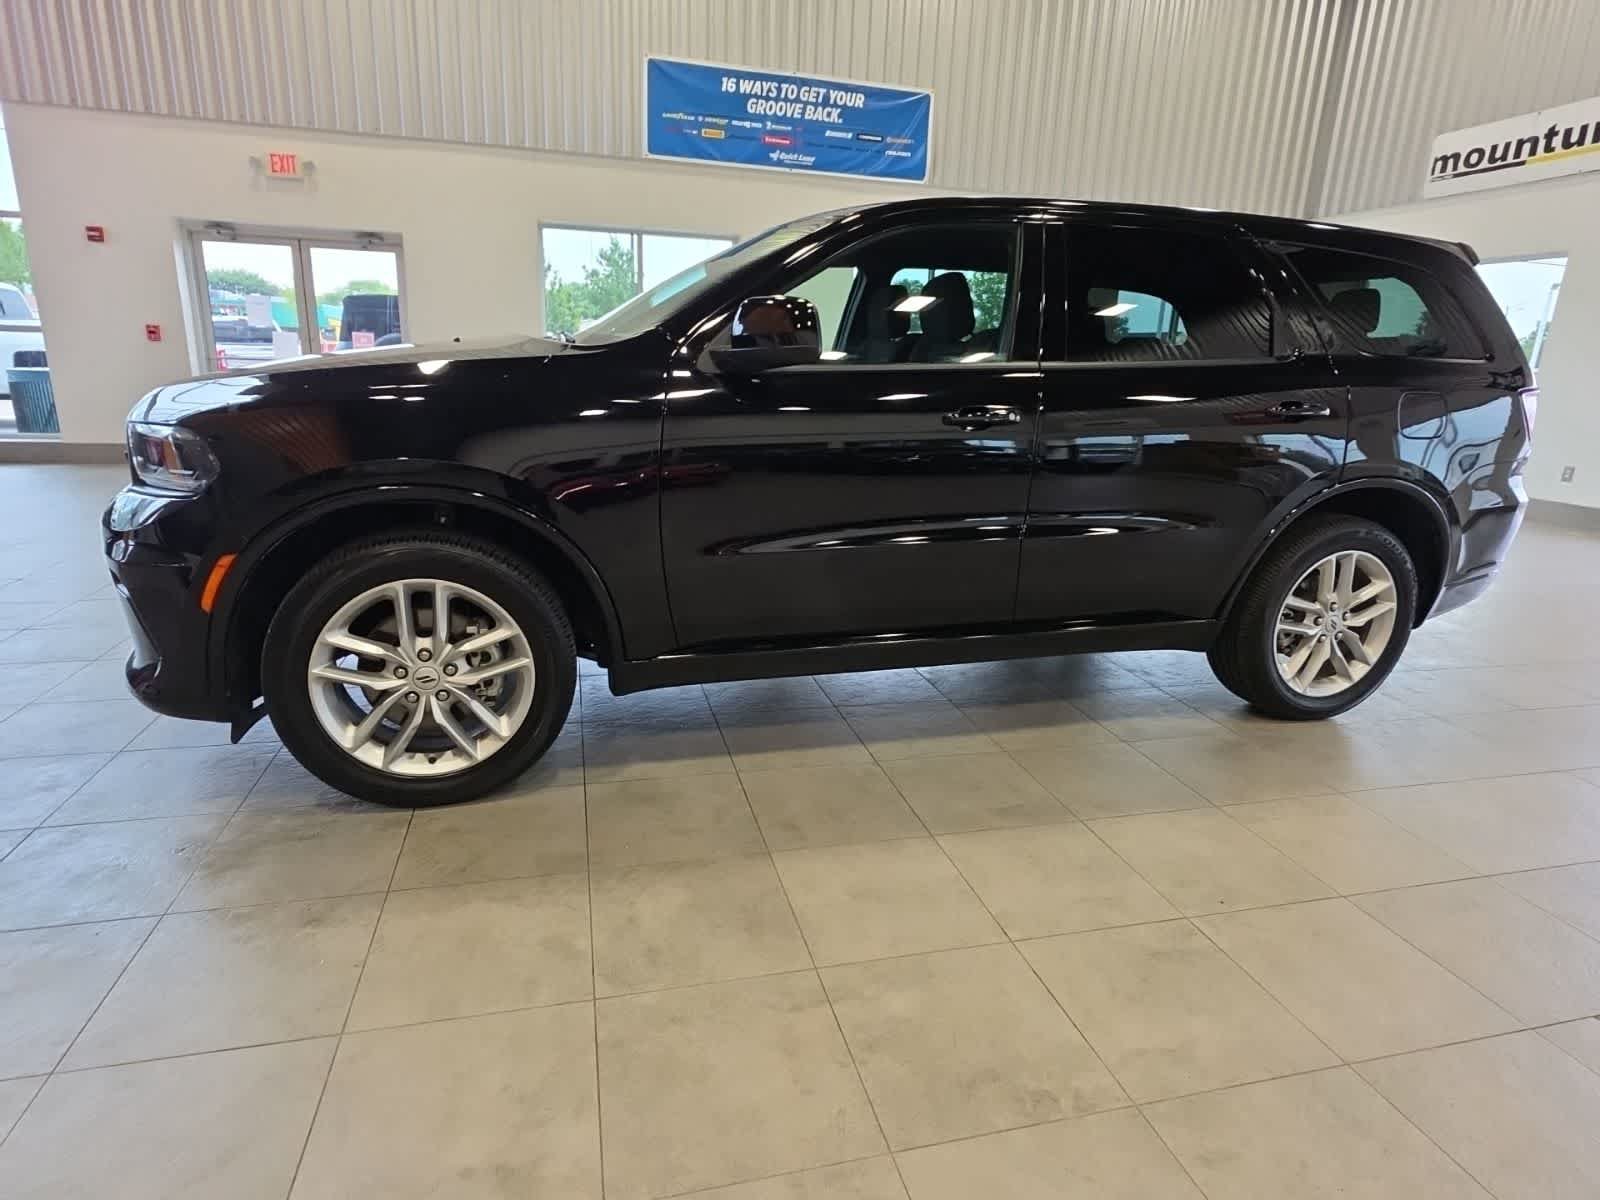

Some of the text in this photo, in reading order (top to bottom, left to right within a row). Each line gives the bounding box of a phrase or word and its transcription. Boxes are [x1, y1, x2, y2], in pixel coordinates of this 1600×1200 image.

[721, 77, 865, 108] 16 WAYS TO GET YOUR
[747, 98, 844, 124] GROOVE BACK.
[270, 153, 297, 174] EXIT
